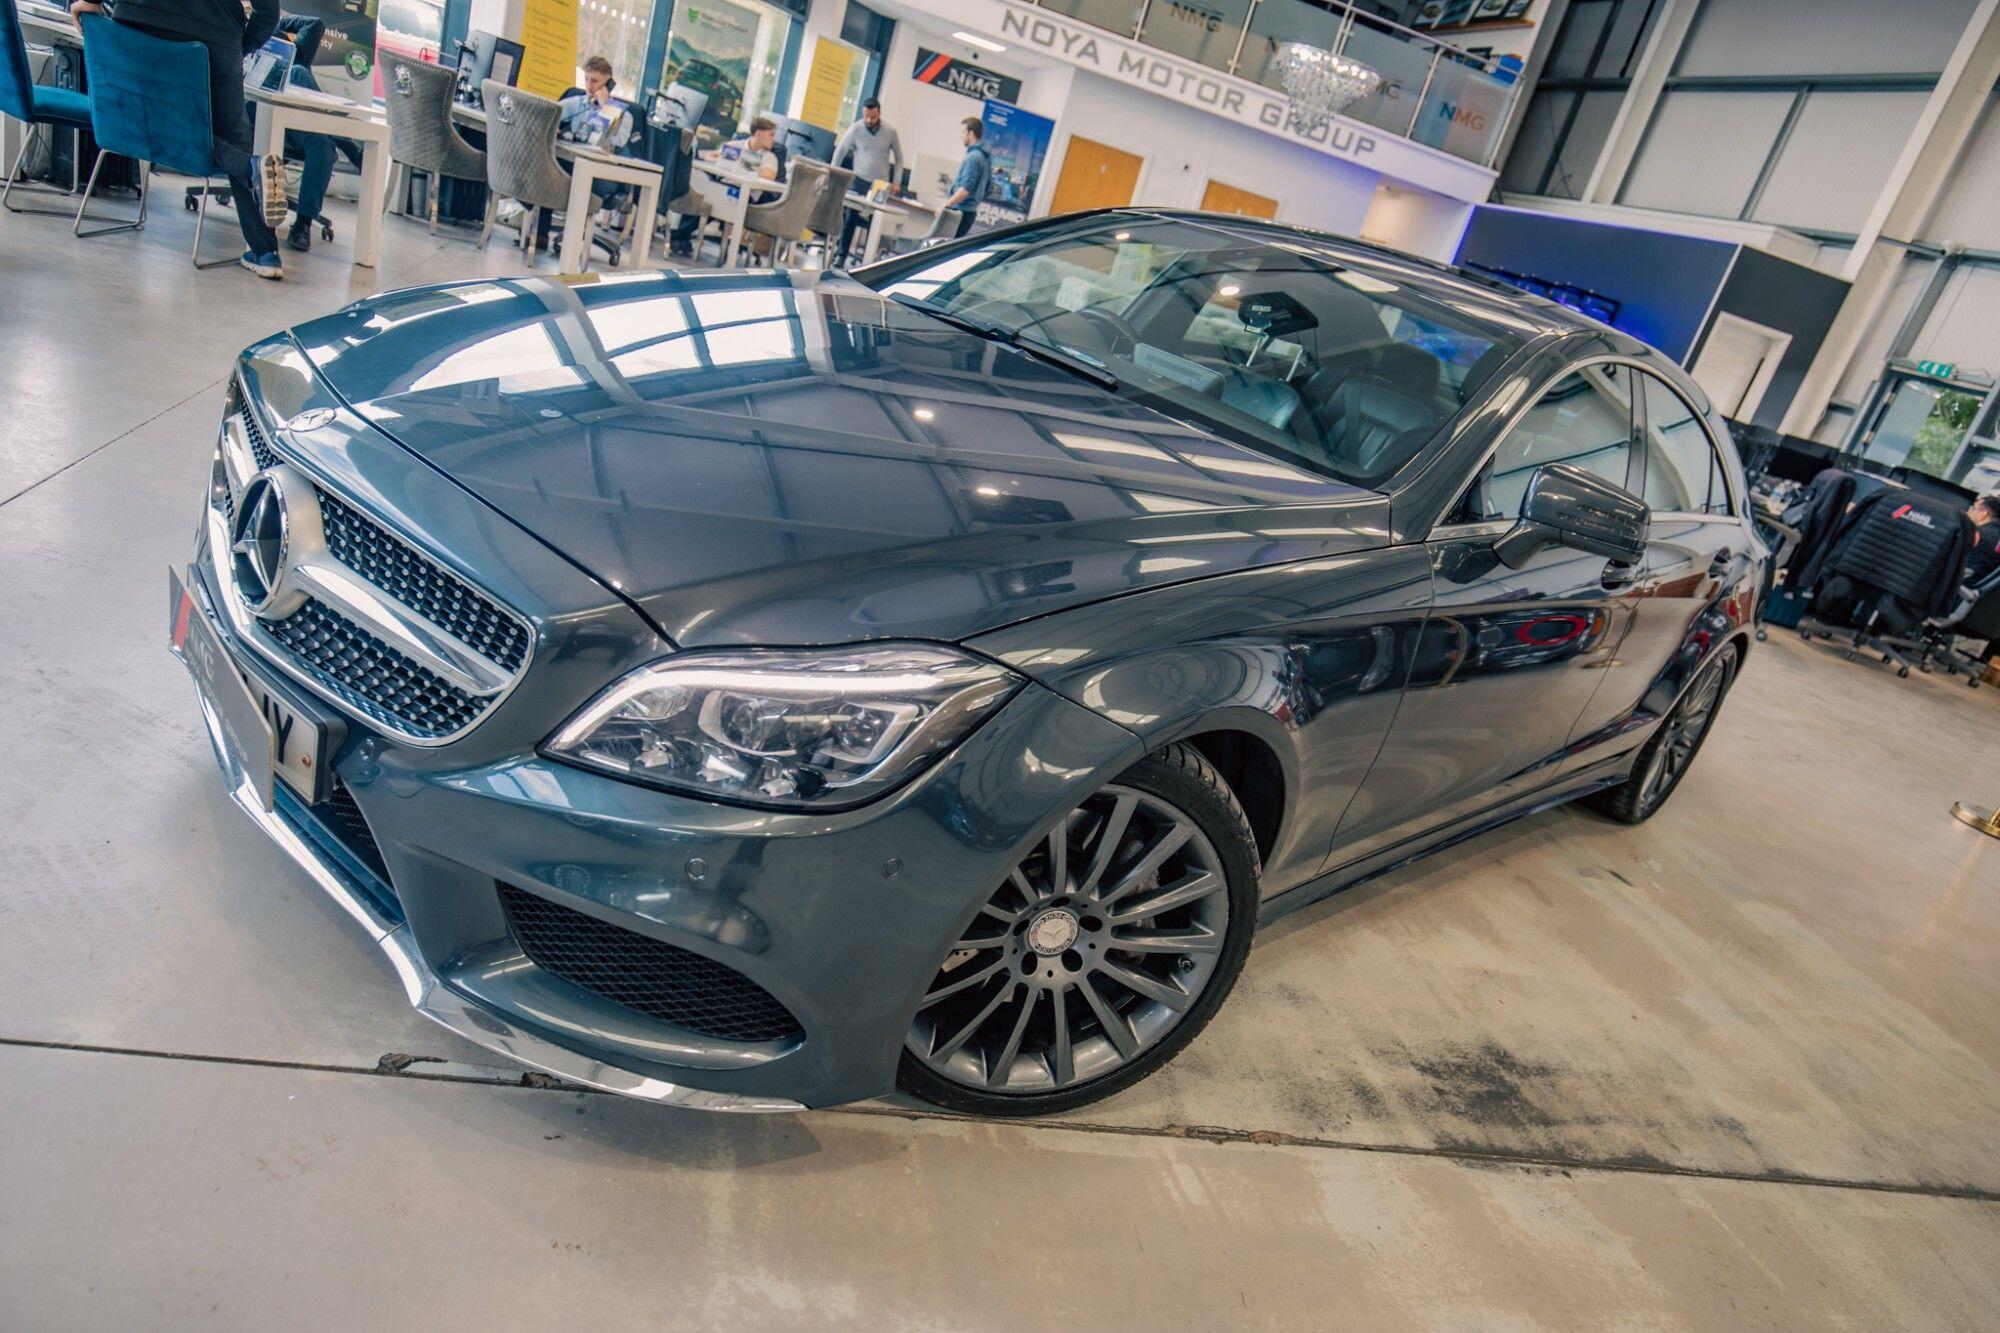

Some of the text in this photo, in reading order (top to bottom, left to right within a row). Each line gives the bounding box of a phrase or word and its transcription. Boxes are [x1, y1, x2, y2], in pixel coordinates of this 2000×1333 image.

[1170, 1, 1223, 33] NMG
[1001, 9, 1100, 65] NOYA
[1117, 50, 1245, 113] MOTOR
[947, 67, 1001, 99] NMG
[1439, 101, 1486, 131] NMG
